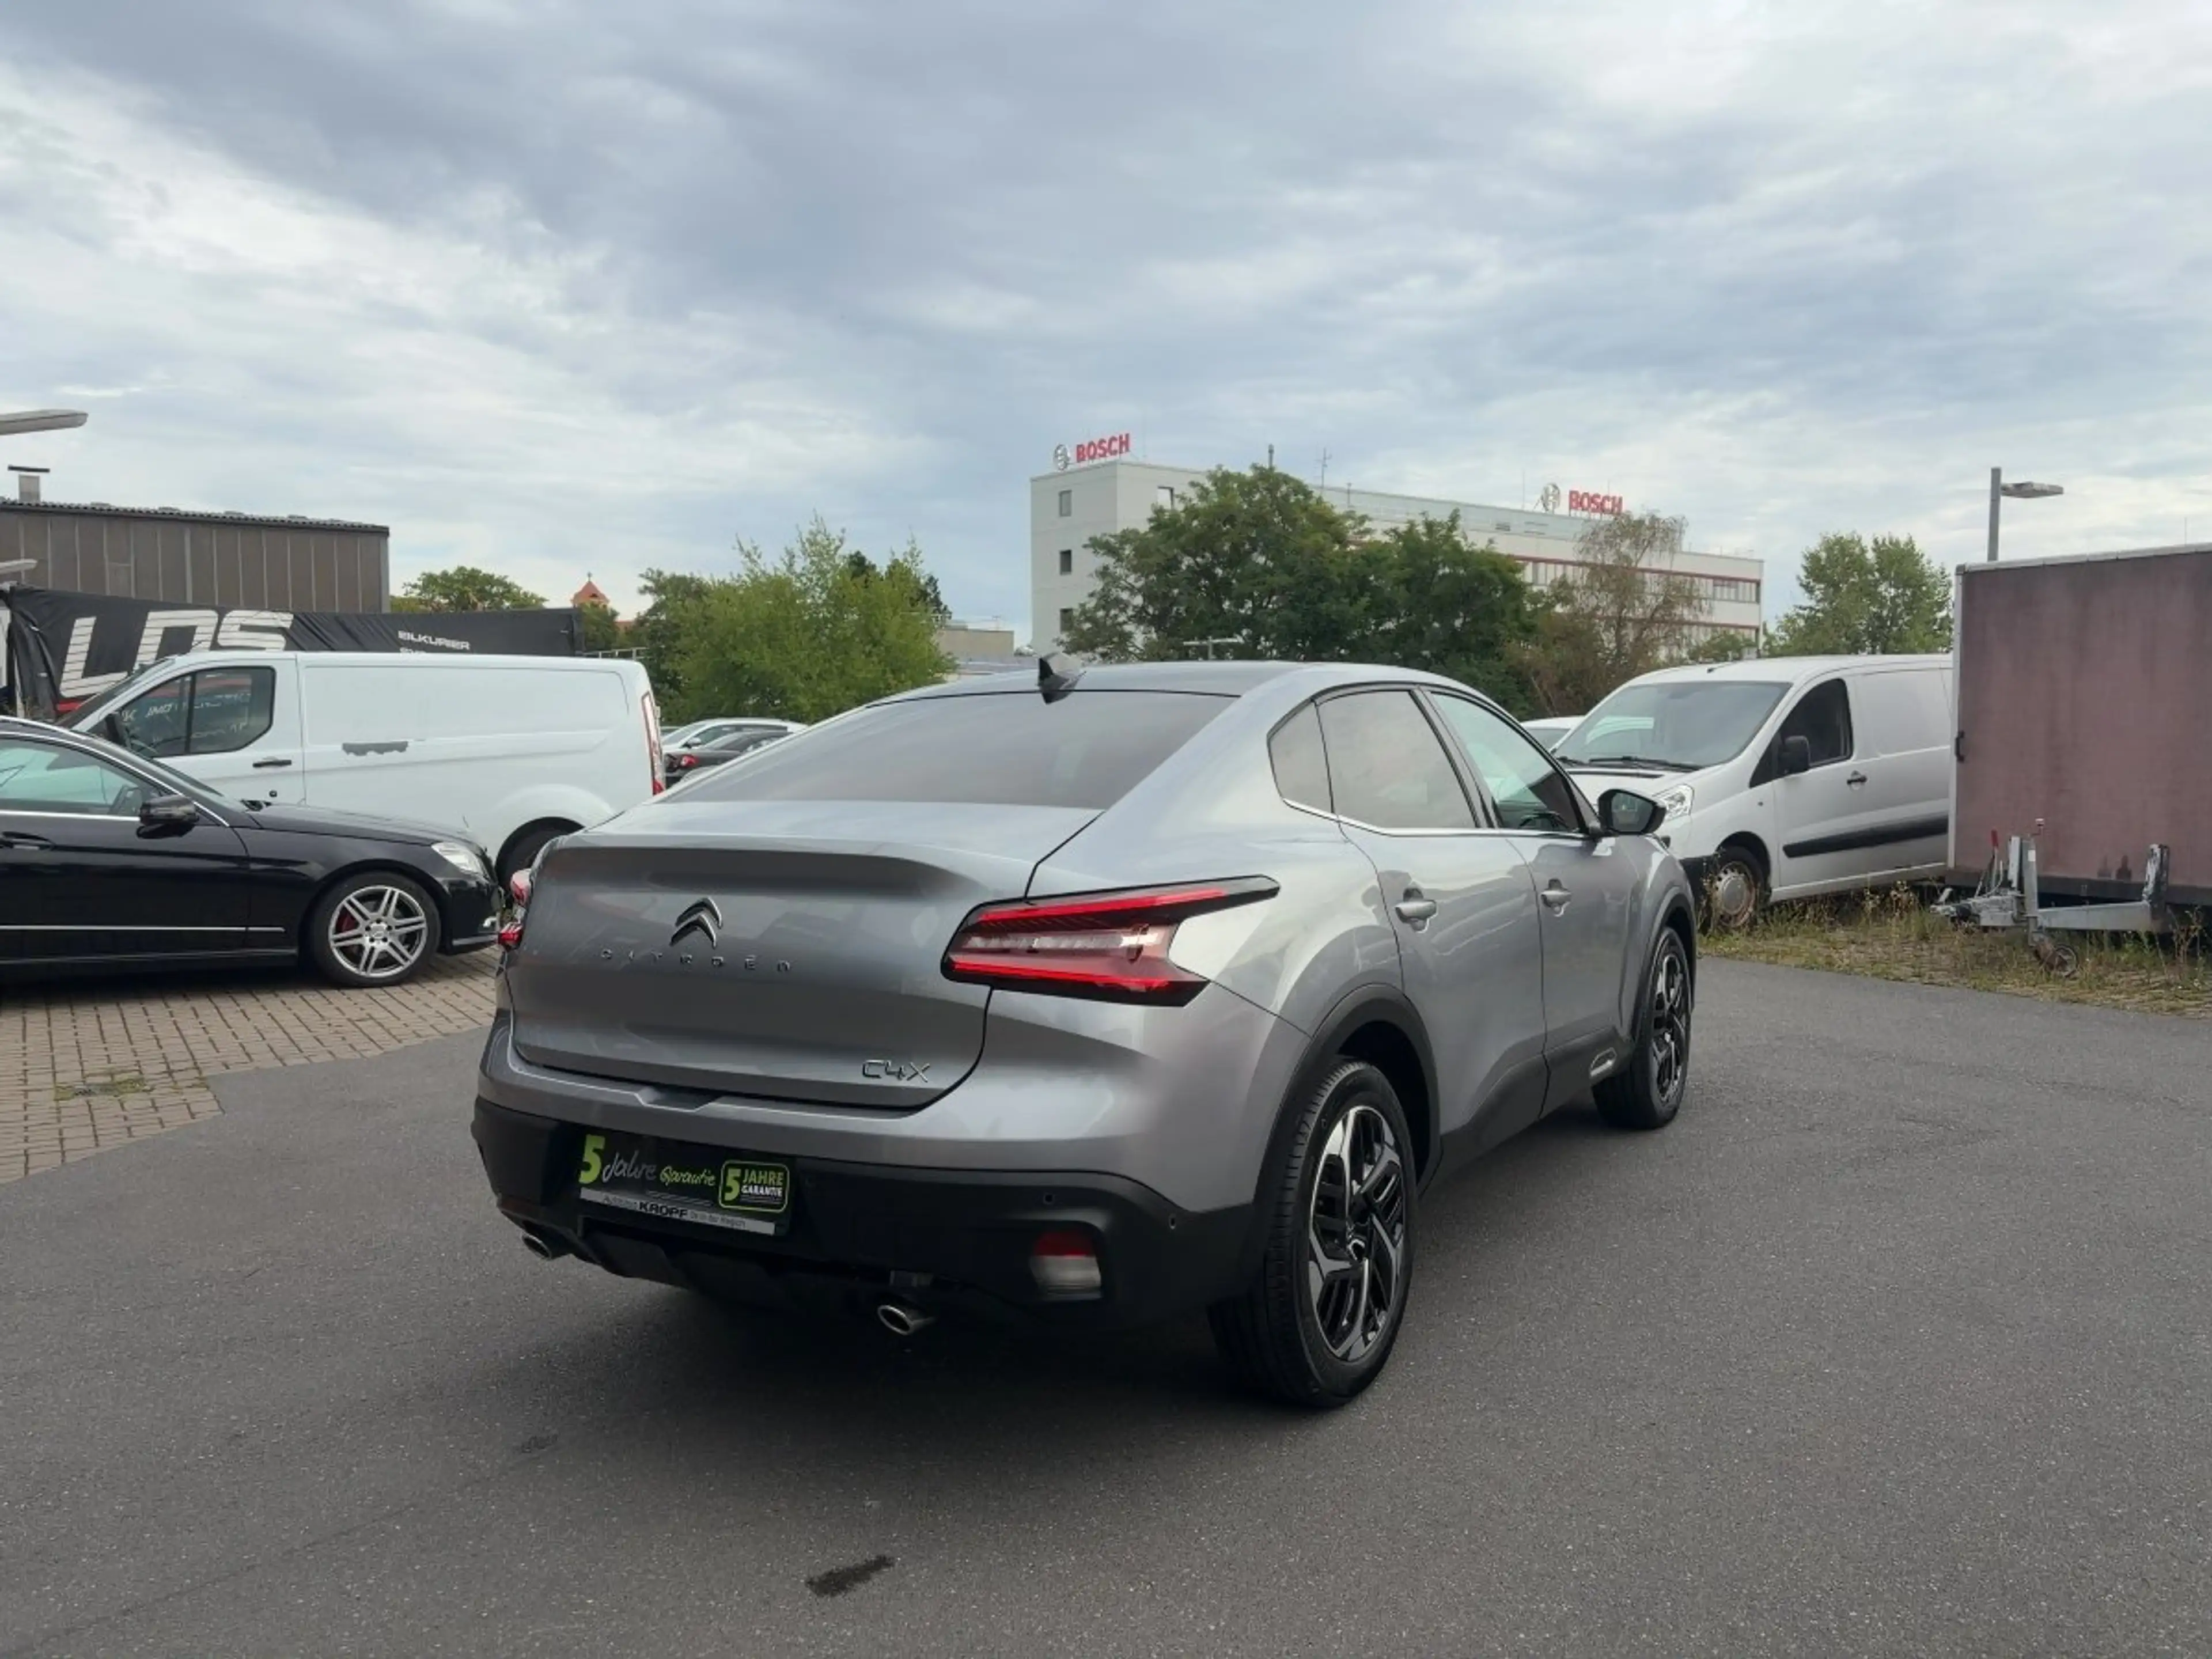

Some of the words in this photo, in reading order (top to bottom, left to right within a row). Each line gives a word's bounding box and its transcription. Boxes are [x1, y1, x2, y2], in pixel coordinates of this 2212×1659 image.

[1076, 433, 1130, 463] BOSCH
[1569, 490, 1623, 514] BOSCH
[578, 1134, 606, 1184] 5
[724, 1168, 741, 1201] 5
[743, 1169, 784, 1185] JAHRE
[639, 1201, 688, 1219] KROPF
